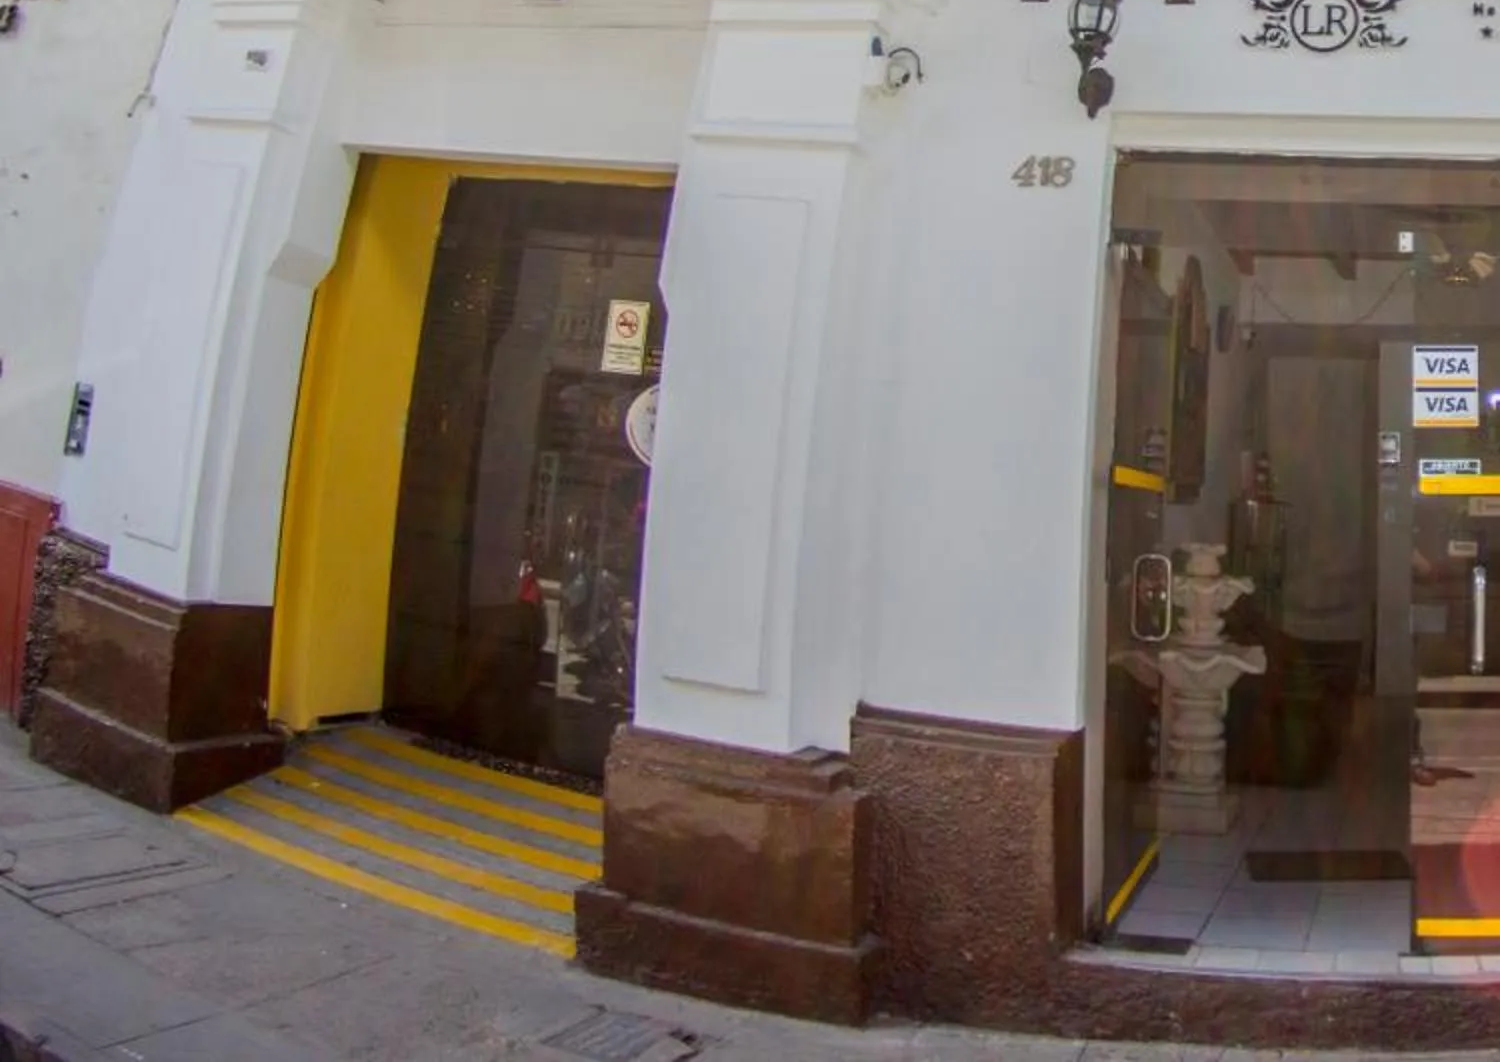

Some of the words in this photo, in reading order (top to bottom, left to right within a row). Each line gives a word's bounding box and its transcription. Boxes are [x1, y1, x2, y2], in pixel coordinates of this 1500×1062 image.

[1300, 4, 1348, 37] LR
[1010, 155, 1076, 188] 418
[1424, 357, 1471, 375] VISA
[1424, 396, 1469, 413] VISA
